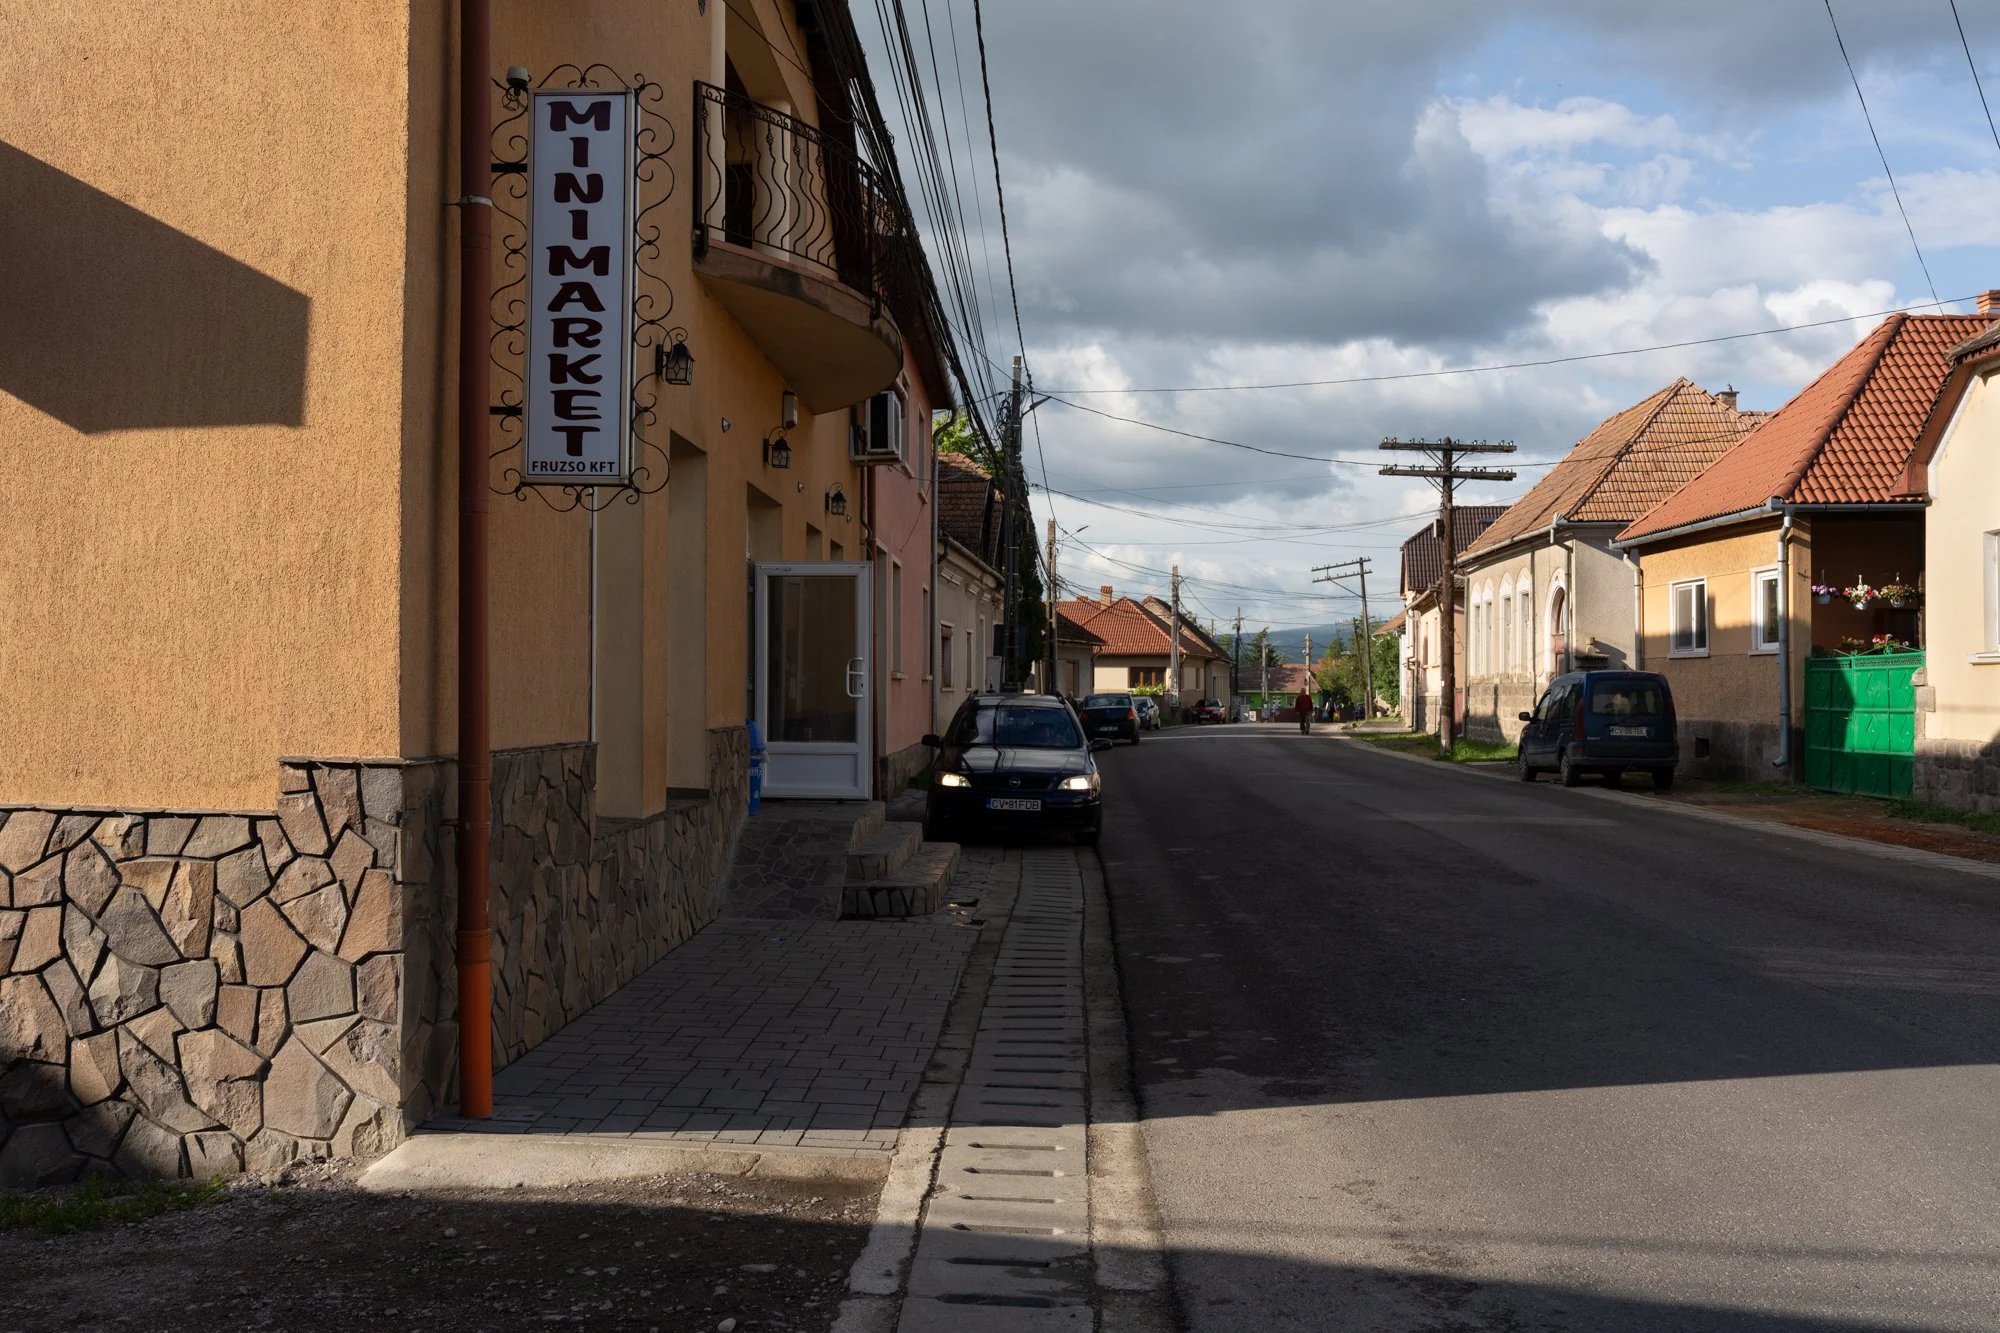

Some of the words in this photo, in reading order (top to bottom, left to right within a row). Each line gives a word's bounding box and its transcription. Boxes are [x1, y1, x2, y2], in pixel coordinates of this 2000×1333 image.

[547, 100, 612, 457] MINIMARKET
[532, 461, 586, 472] FRUZSO
[590, 461, 615, 473] KFT
